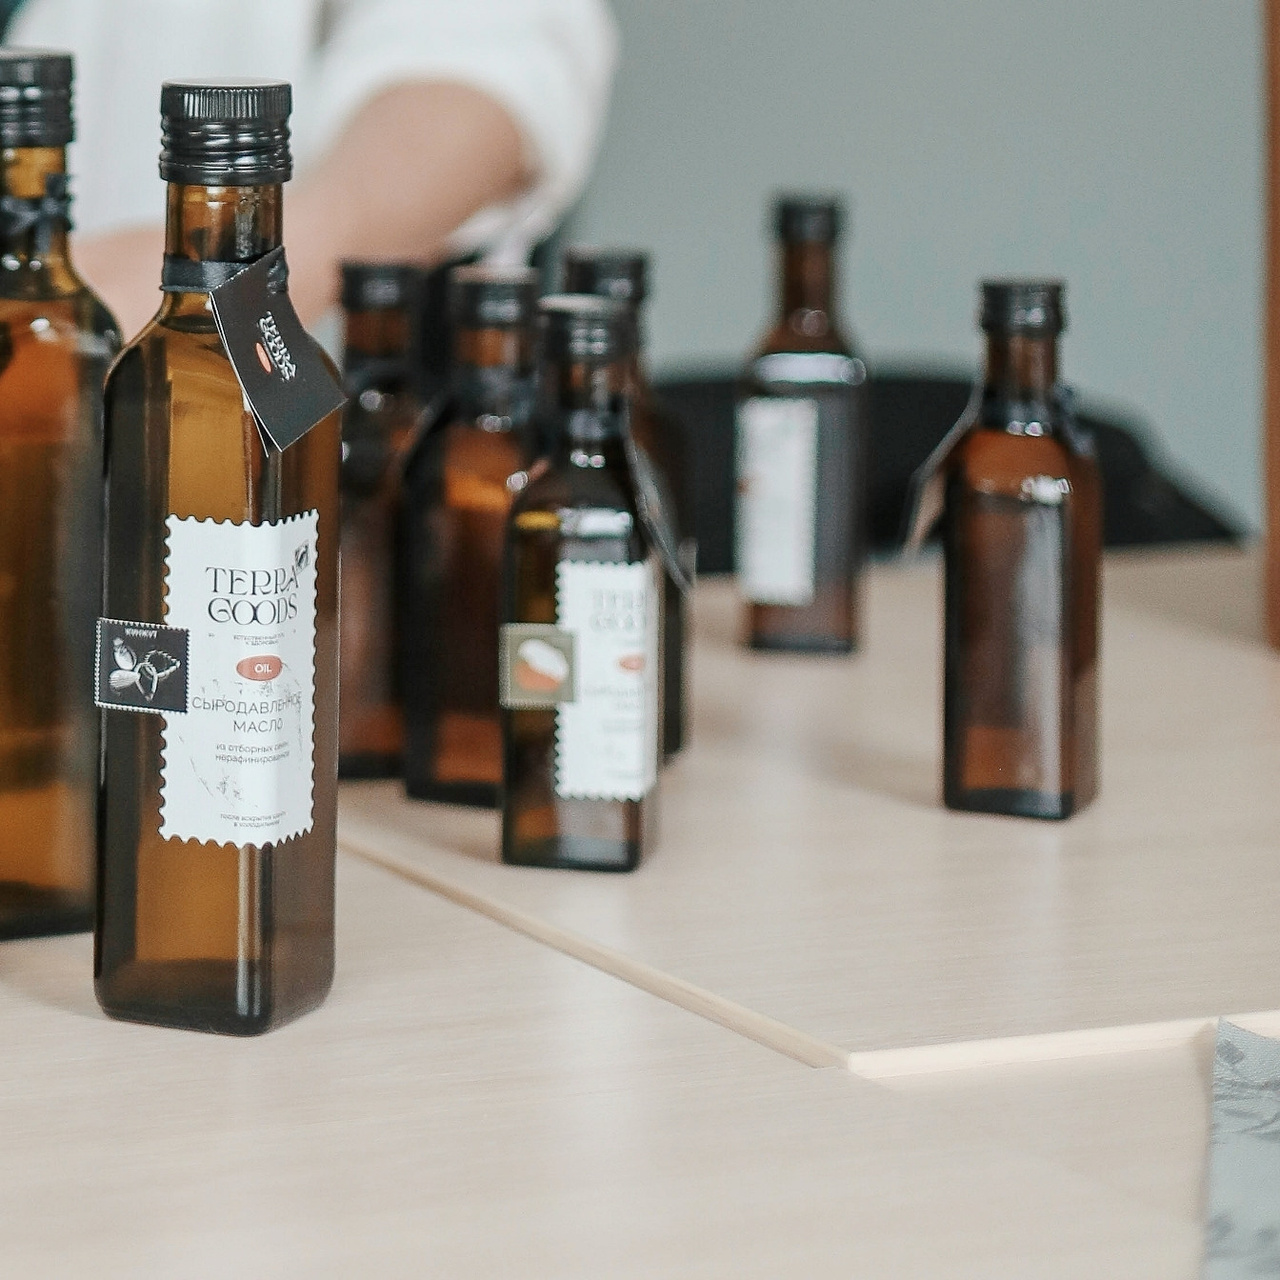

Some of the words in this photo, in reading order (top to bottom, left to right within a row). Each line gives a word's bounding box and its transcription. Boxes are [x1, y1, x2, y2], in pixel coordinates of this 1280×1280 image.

[259, 318, 290, 380] GOODS
[265, 311, 296, 378] TERRA
[205, 565, 299, 596] TERRA
[208, 593, 298, 625] GOODS
[254, 663, 272, 674] OIL
[233, 717, 283, 733] МАСЛО
